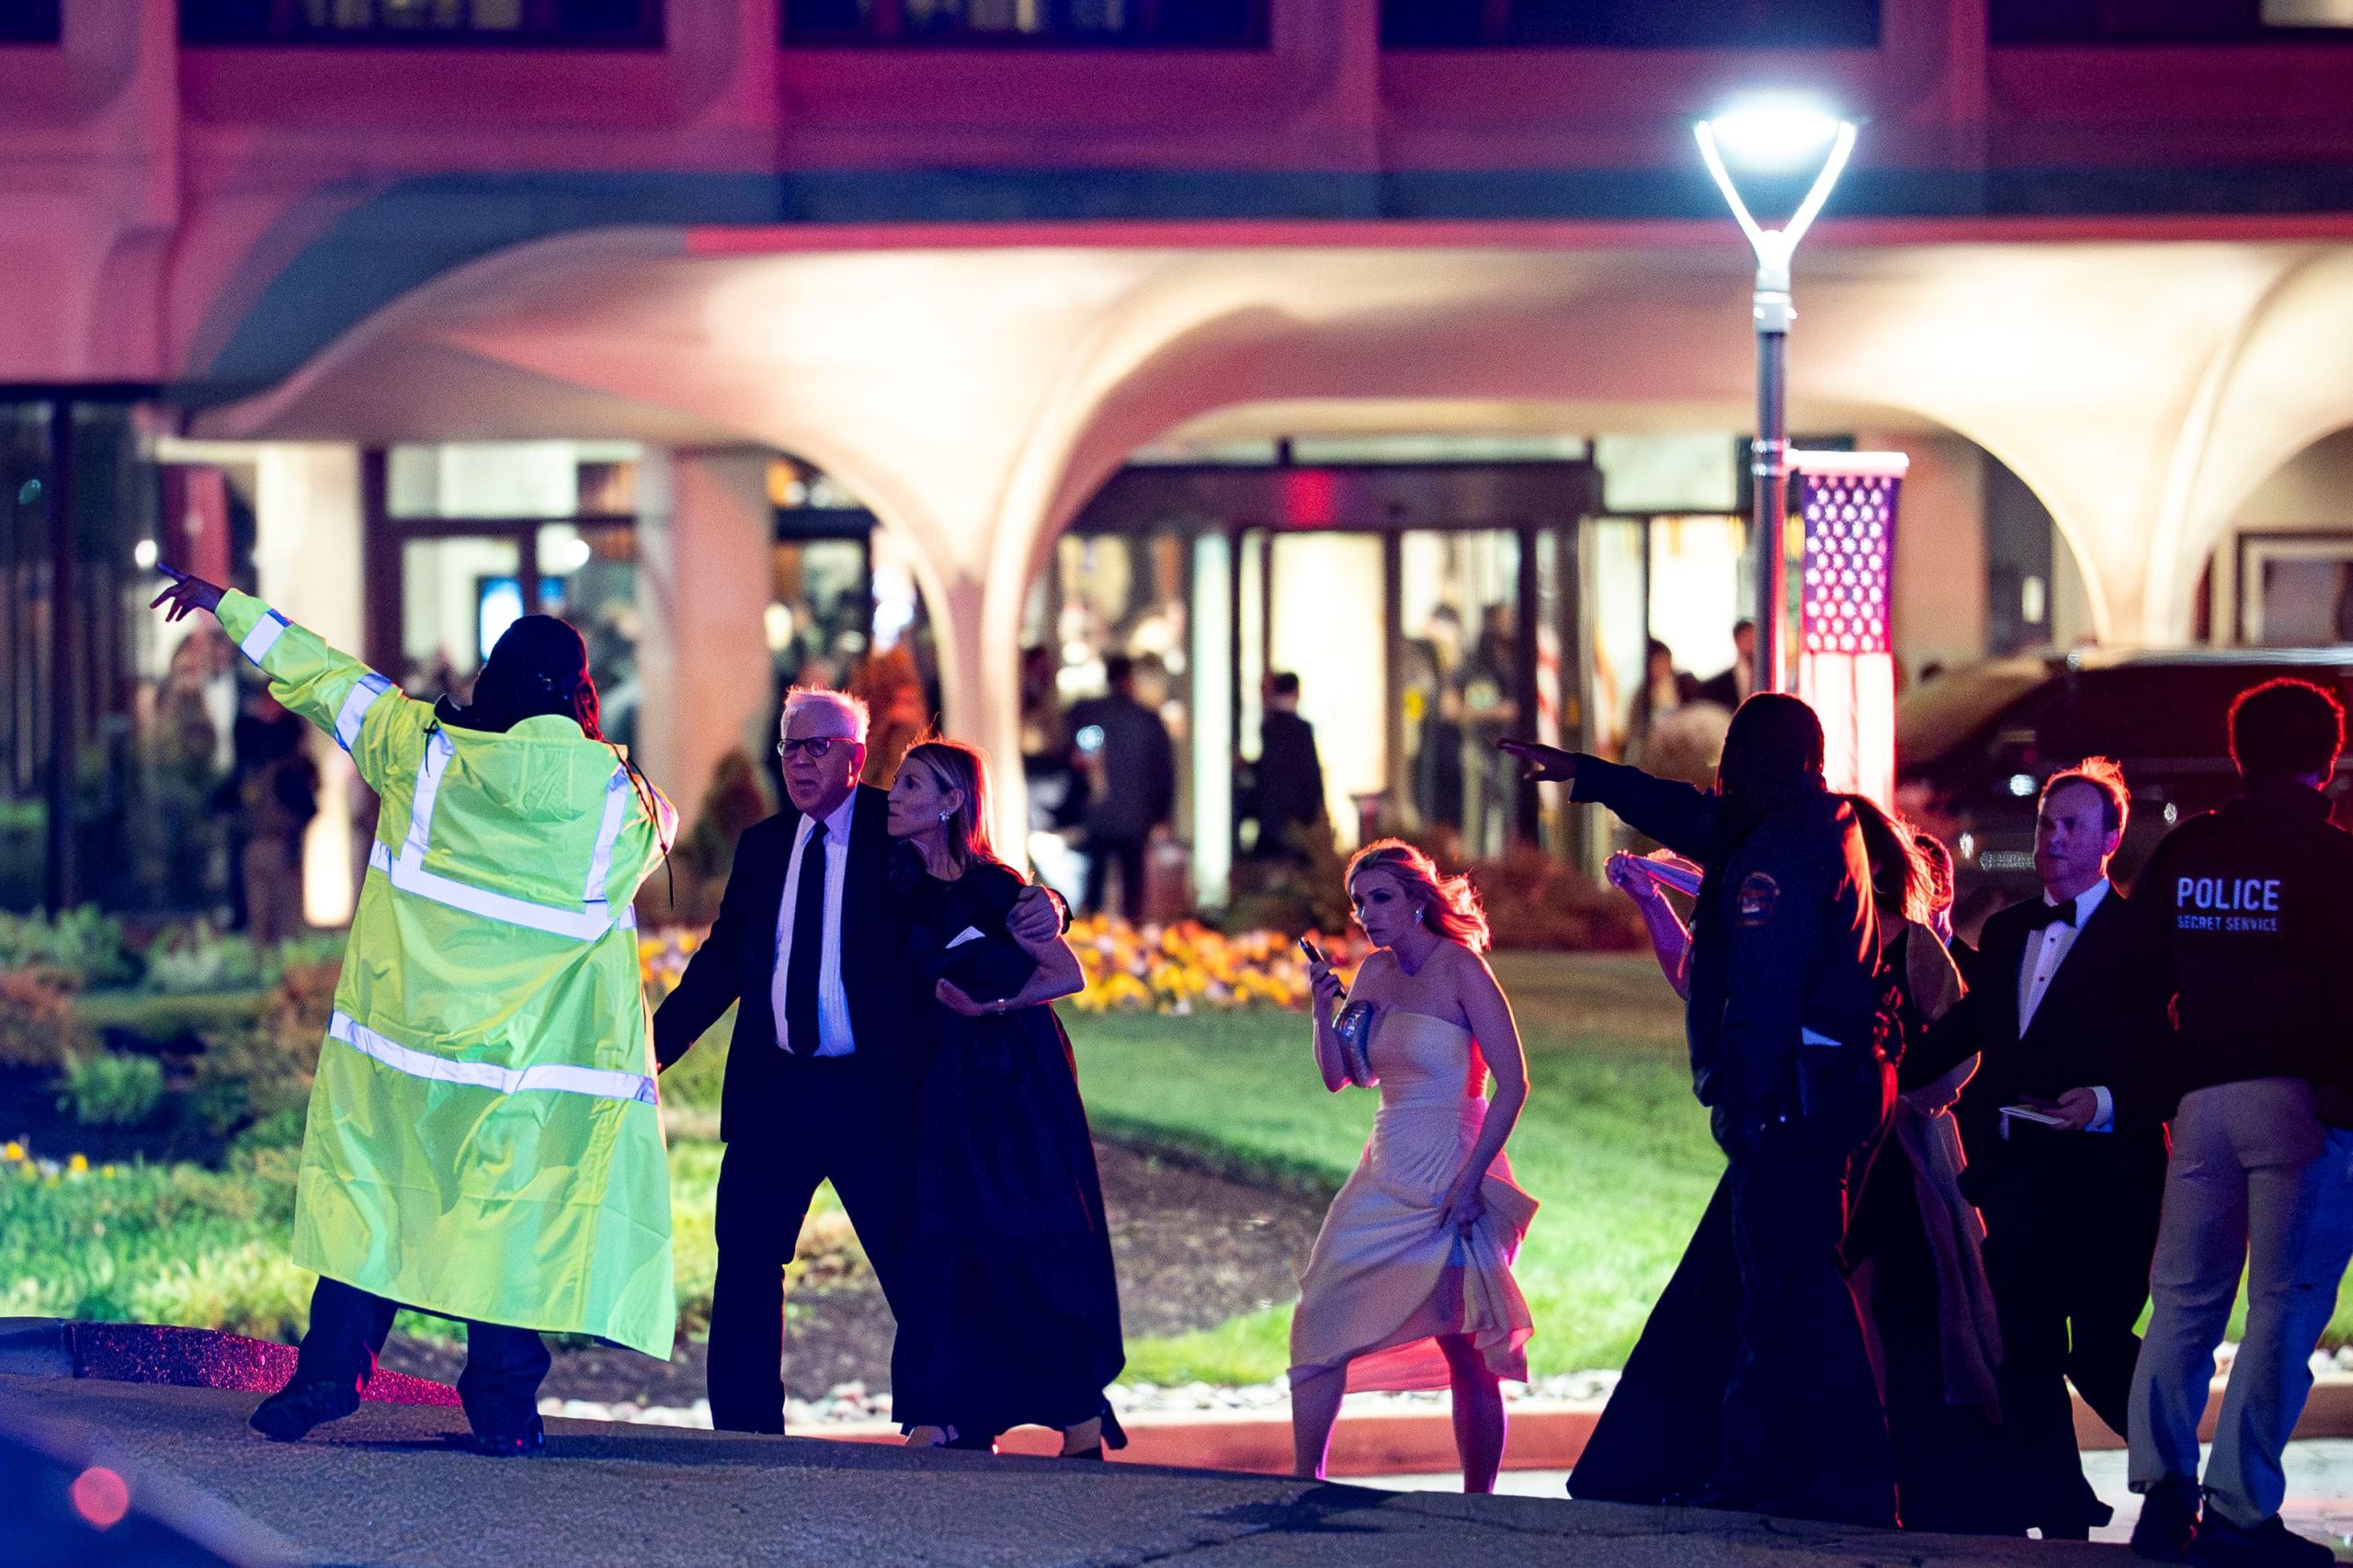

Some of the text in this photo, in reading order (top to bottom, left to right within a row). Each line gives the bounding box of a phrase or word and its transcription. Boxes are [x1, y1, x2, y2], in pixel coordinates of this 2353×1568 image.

[2177, 877, 2280, 911] POLICE
[2177, 915, 2277, 932] SECRET SERVICE
